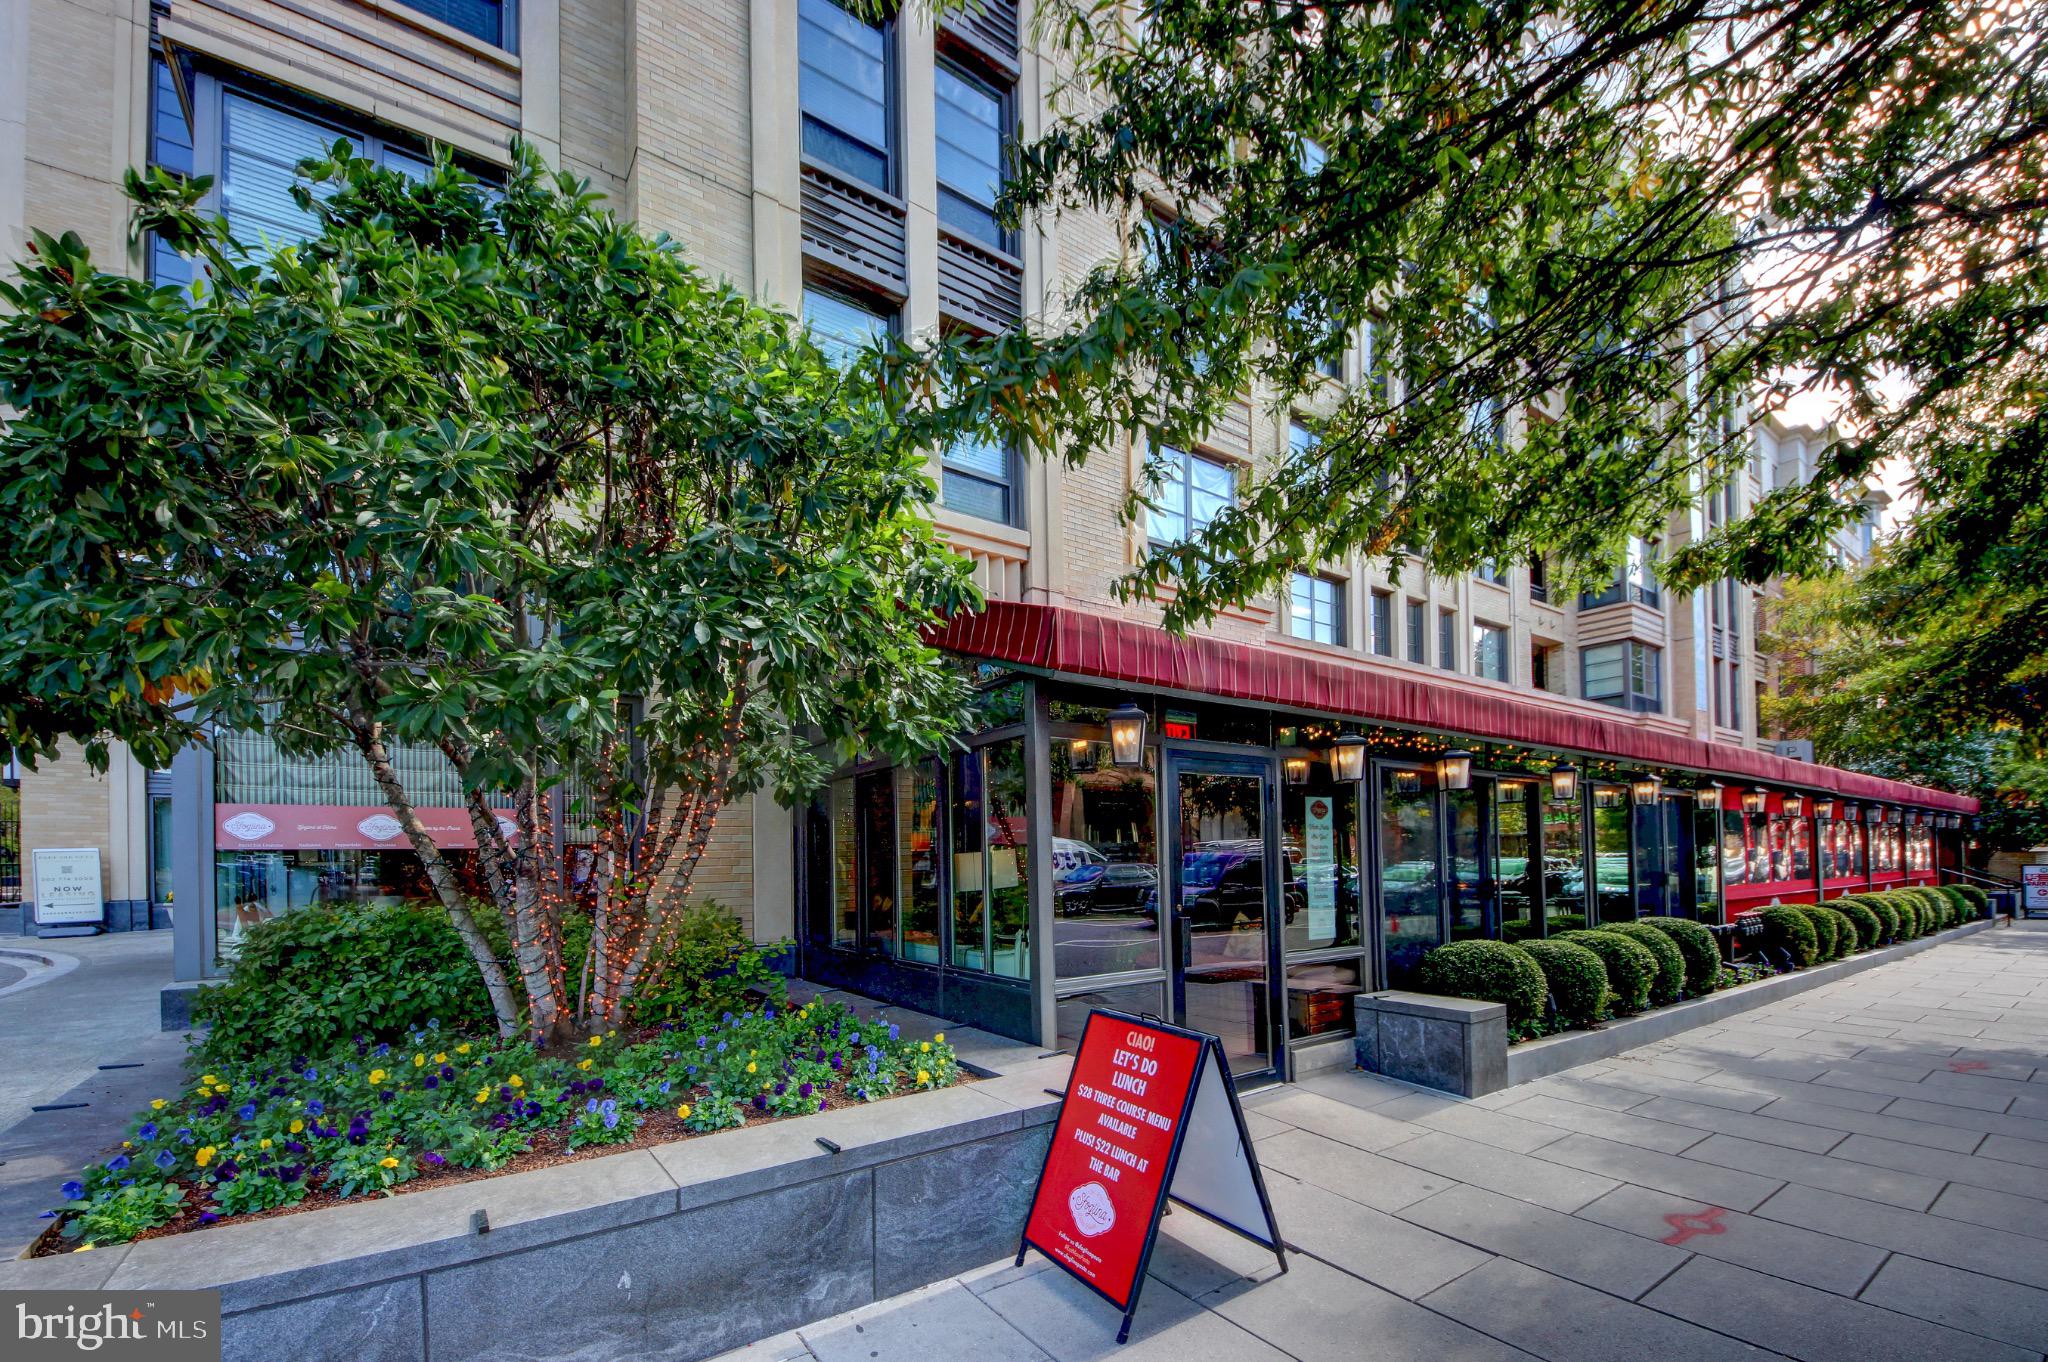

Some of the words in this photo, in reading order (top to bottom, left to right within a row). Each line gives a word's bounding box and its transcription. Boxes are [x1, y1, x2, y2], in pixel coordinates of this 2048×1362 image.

[1127, 1031, 1155, 1052] CIAO!
[1113, 1049, 1139, 1070] LET'S
[1141, 1057, 1158, 1076] DO
[1112, 1071, 1147, 1096] LUNCH
[1077, 1084, 1092, 1099] $28
[1093, 1090, 1117, 1109] THREE
[1116, 1100, 1147, 1121] COURSE
[1147, 1111, 1172, 1131] MENU
[1098, 1113, 1137, 1139] AVAILABLE
[1074, 1128, 1096, 1147] PLUS!
[1095, 1138, 1111, 1154] $22
[1111, 1146, 1138, 1168] LUNCH
[1137, 1159, 1149, 1173] AT
[1089, 1157, 1104, 1173] THE
[1103, 1164, 1121, 1182] BAR
